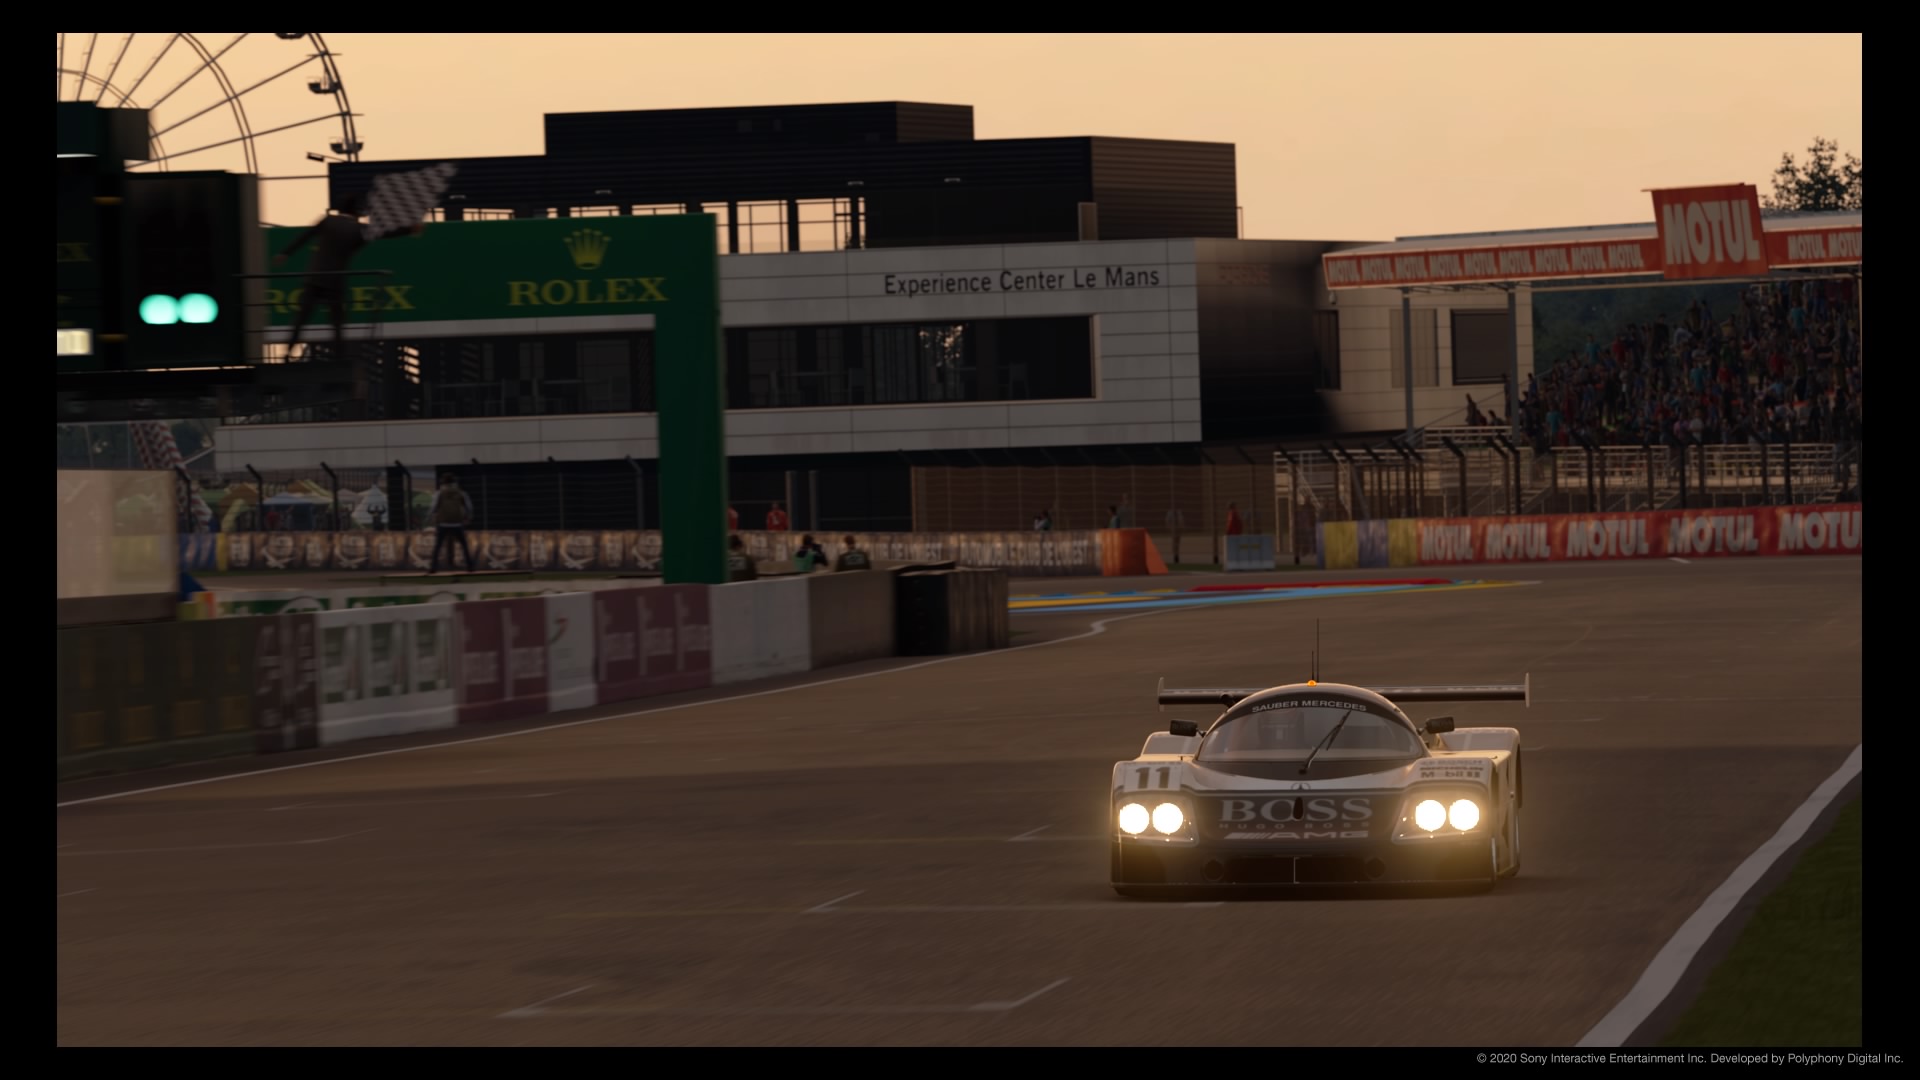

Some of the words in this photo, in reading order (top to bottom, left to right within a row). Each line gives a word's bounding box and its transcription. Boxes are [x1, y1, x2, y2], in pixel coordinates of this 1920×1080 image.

[1662, 199, 1760, 265] MOTUL
[1787, 233, 1826, 261] MOTUL
[507, 277, 670, 306] ROLEX
[884, 273, 992, 298] Experience
[1000, 269, 1065, 292] Center
[1073, 268, 1097, 289] Le
[1105, 266, 1159, 287] Mans
[263, 284, 417, 313] REX
[1421, 524, 1473, 561] MOTUL
[1485, 522, 1551, 560] MOTUL
[1566, 518, 1650, 558] MOTUL
[1666, 514, 1758, 555] MOTUL
[1252, 701, 1298, 712] SAUBER
[1302, 700, 1366, 711] MERCEDES
[1136, 767, 1170, 789] 11
[1218, 798, 1373, 822] BOSS
[1269, 830, 1369, 840] AMG
